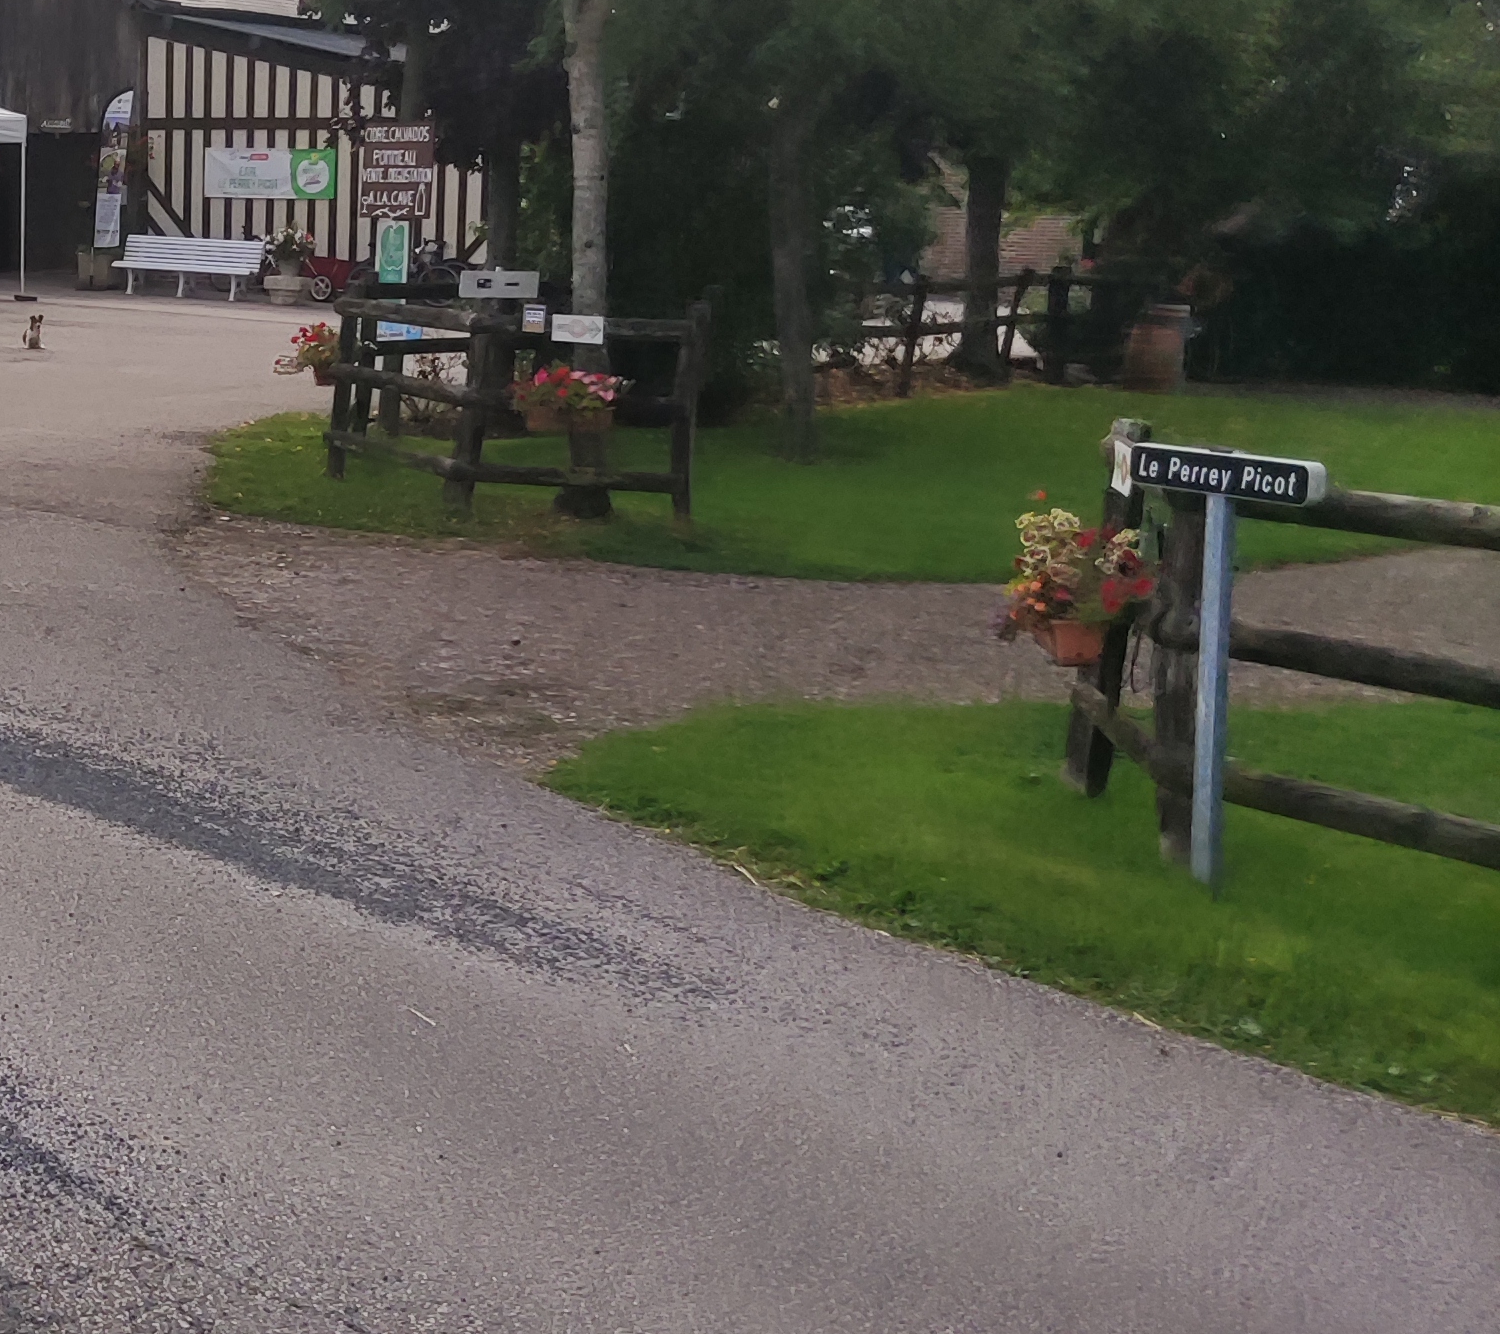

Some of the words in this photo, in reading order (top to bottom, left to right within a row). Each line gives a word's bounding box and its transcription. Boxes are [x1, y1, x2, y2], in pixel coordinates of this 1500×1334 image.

[364, 126, 388, 142] CIDRE
[389, 126, 430, 142] CALVADOS
[372, 149, 417, 165] POMMEAU
[1138, 453, 1158, 478] Le
[1167, 456, 1232, 492] Perrey
[1240, 465, 1297, 497] Picot
